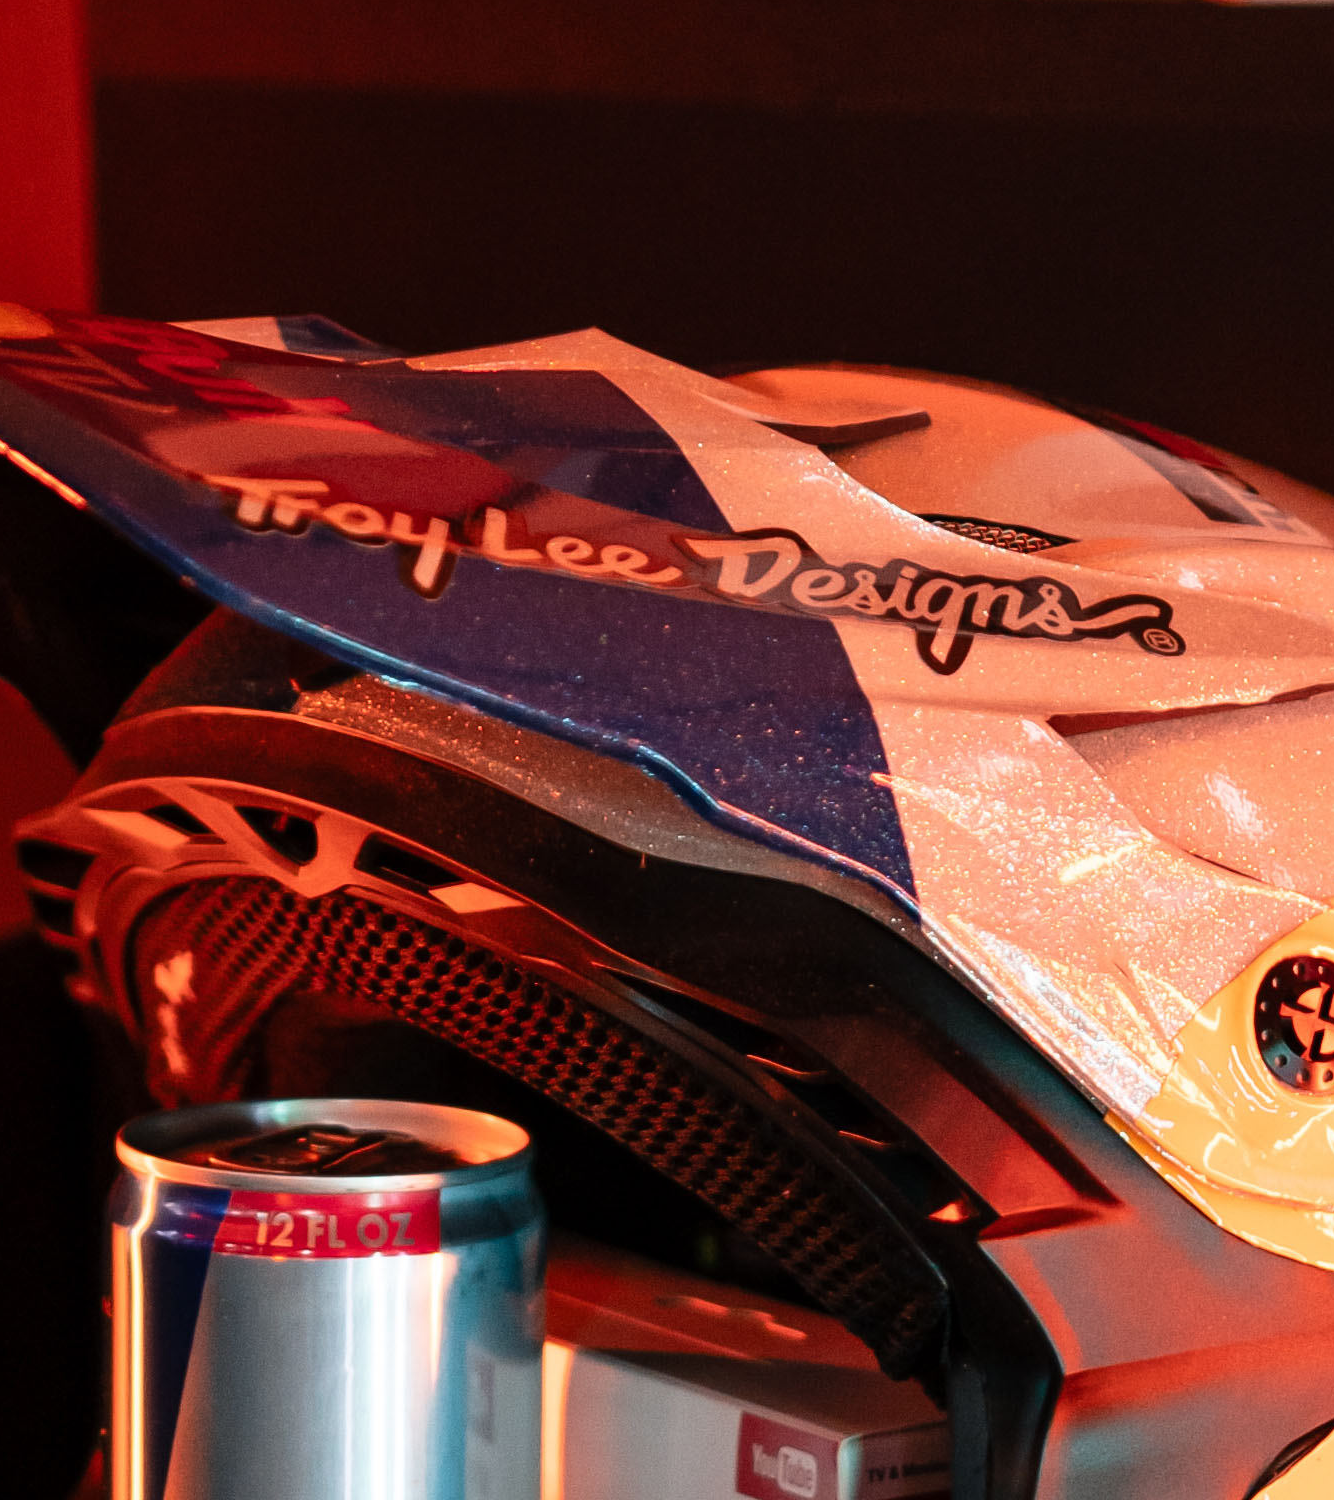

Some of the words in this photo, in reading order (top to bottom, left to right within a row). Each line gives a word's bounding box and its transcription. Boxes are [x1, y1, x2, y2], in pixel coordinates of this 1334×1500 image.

[203, 473, 451, 590] Troy
[481, 506, 684, 584] Lee
[255, 1212, 294, 1248] 12
[306, 1213, 347, 1249] FL
[356, 1212, 415, 1248] OZ
